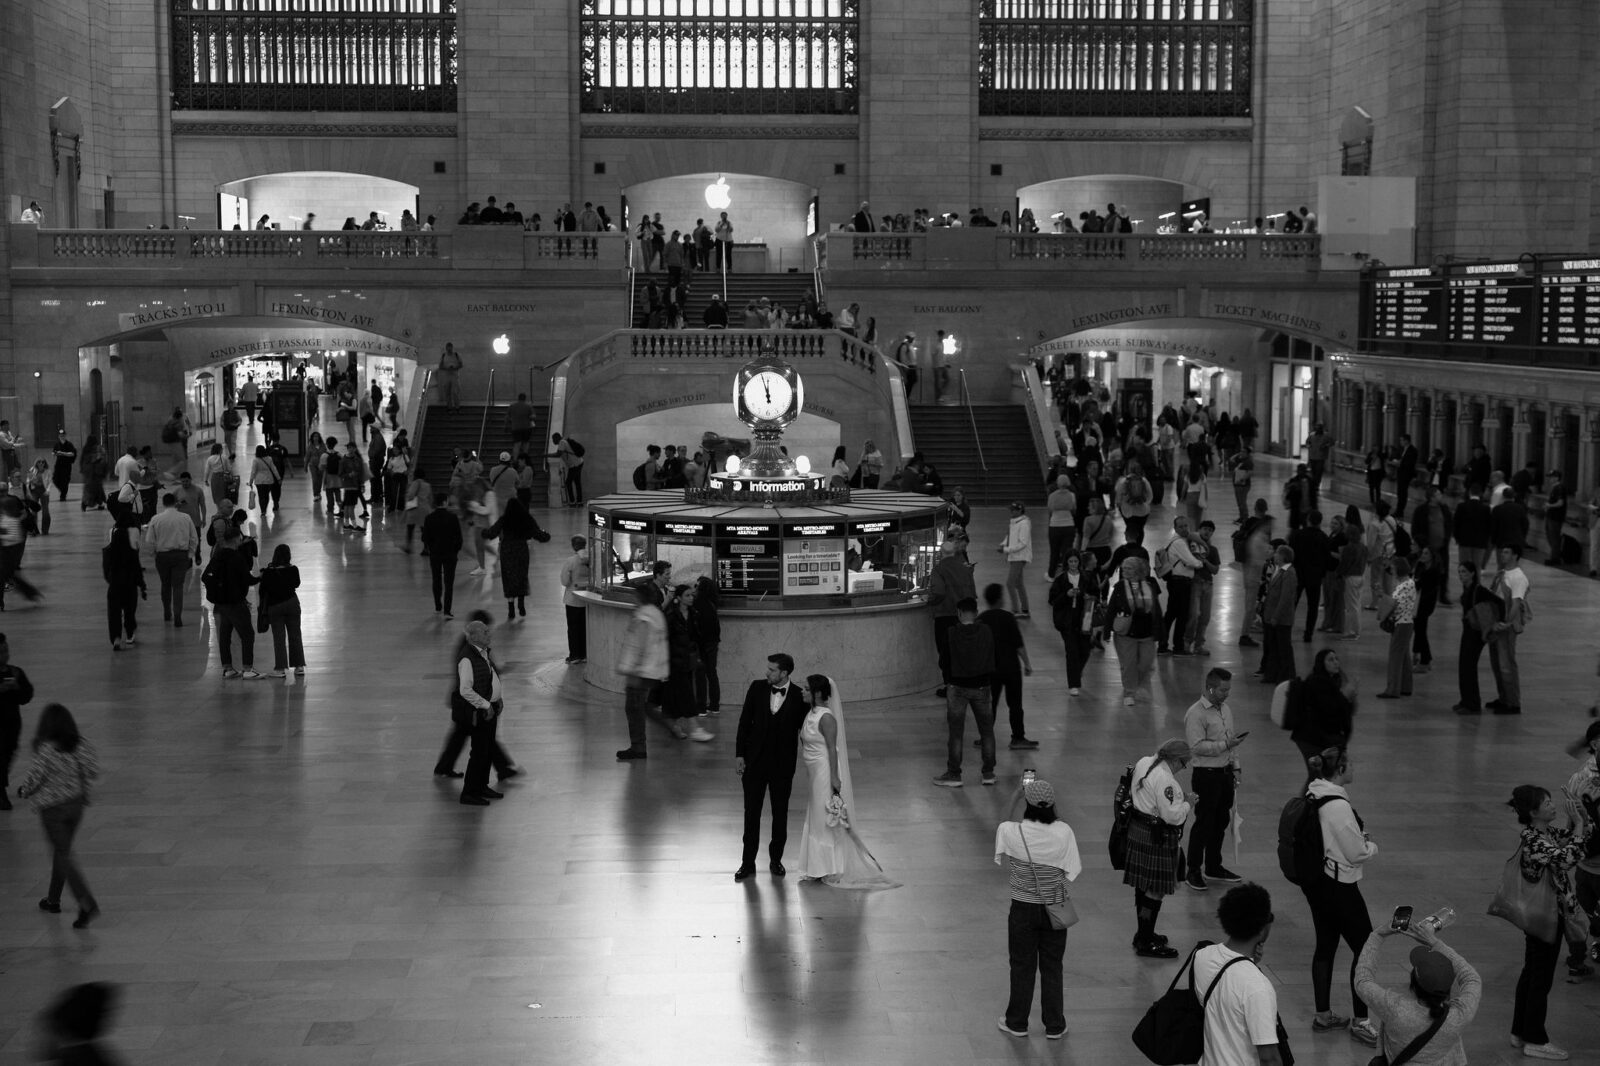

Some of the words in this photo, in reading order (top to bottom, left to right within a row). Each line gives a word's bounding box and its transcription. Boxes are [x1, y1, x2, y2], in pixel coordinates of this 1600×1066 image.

[129, 308, 178, 326] TRACKS
[182, 306, 192, 317] 21
[195, 304, 213, 314] TO
[215, 303, 226, 313] 11
[271, 302, 347, 322] LEXINGTON
[350, 314, 375, 328] AVE
[467, 304, 489, 312] EAST
[492, 304, 536, 312] BALCONY
[913, 305, 937, 313] EAST
[938, 305, 982, 313] BALCONY
[1072, 306, 1145, 328] LEXINGTON
[1148, 304, 1171, 315] AVE
[1214, 304, 1257, 317] TICKET
[1260, 309, 1322, 331] MACHINES
[209, 346, 237, 360] 42ND
[238, 340, 275, 353] STREET
[278, 338, 322, 348] PASSAGE
[331, 338, 375, 349] SUBWAY
[1036, 341, 1075, 353] STREET
[1078, 338, 1121, 347] PASSAGE
[1126, 338, 1169, 350] SUBWAY
[636, 398, 668, 412] TRACKS
[750, 481, 805, 491] Information
